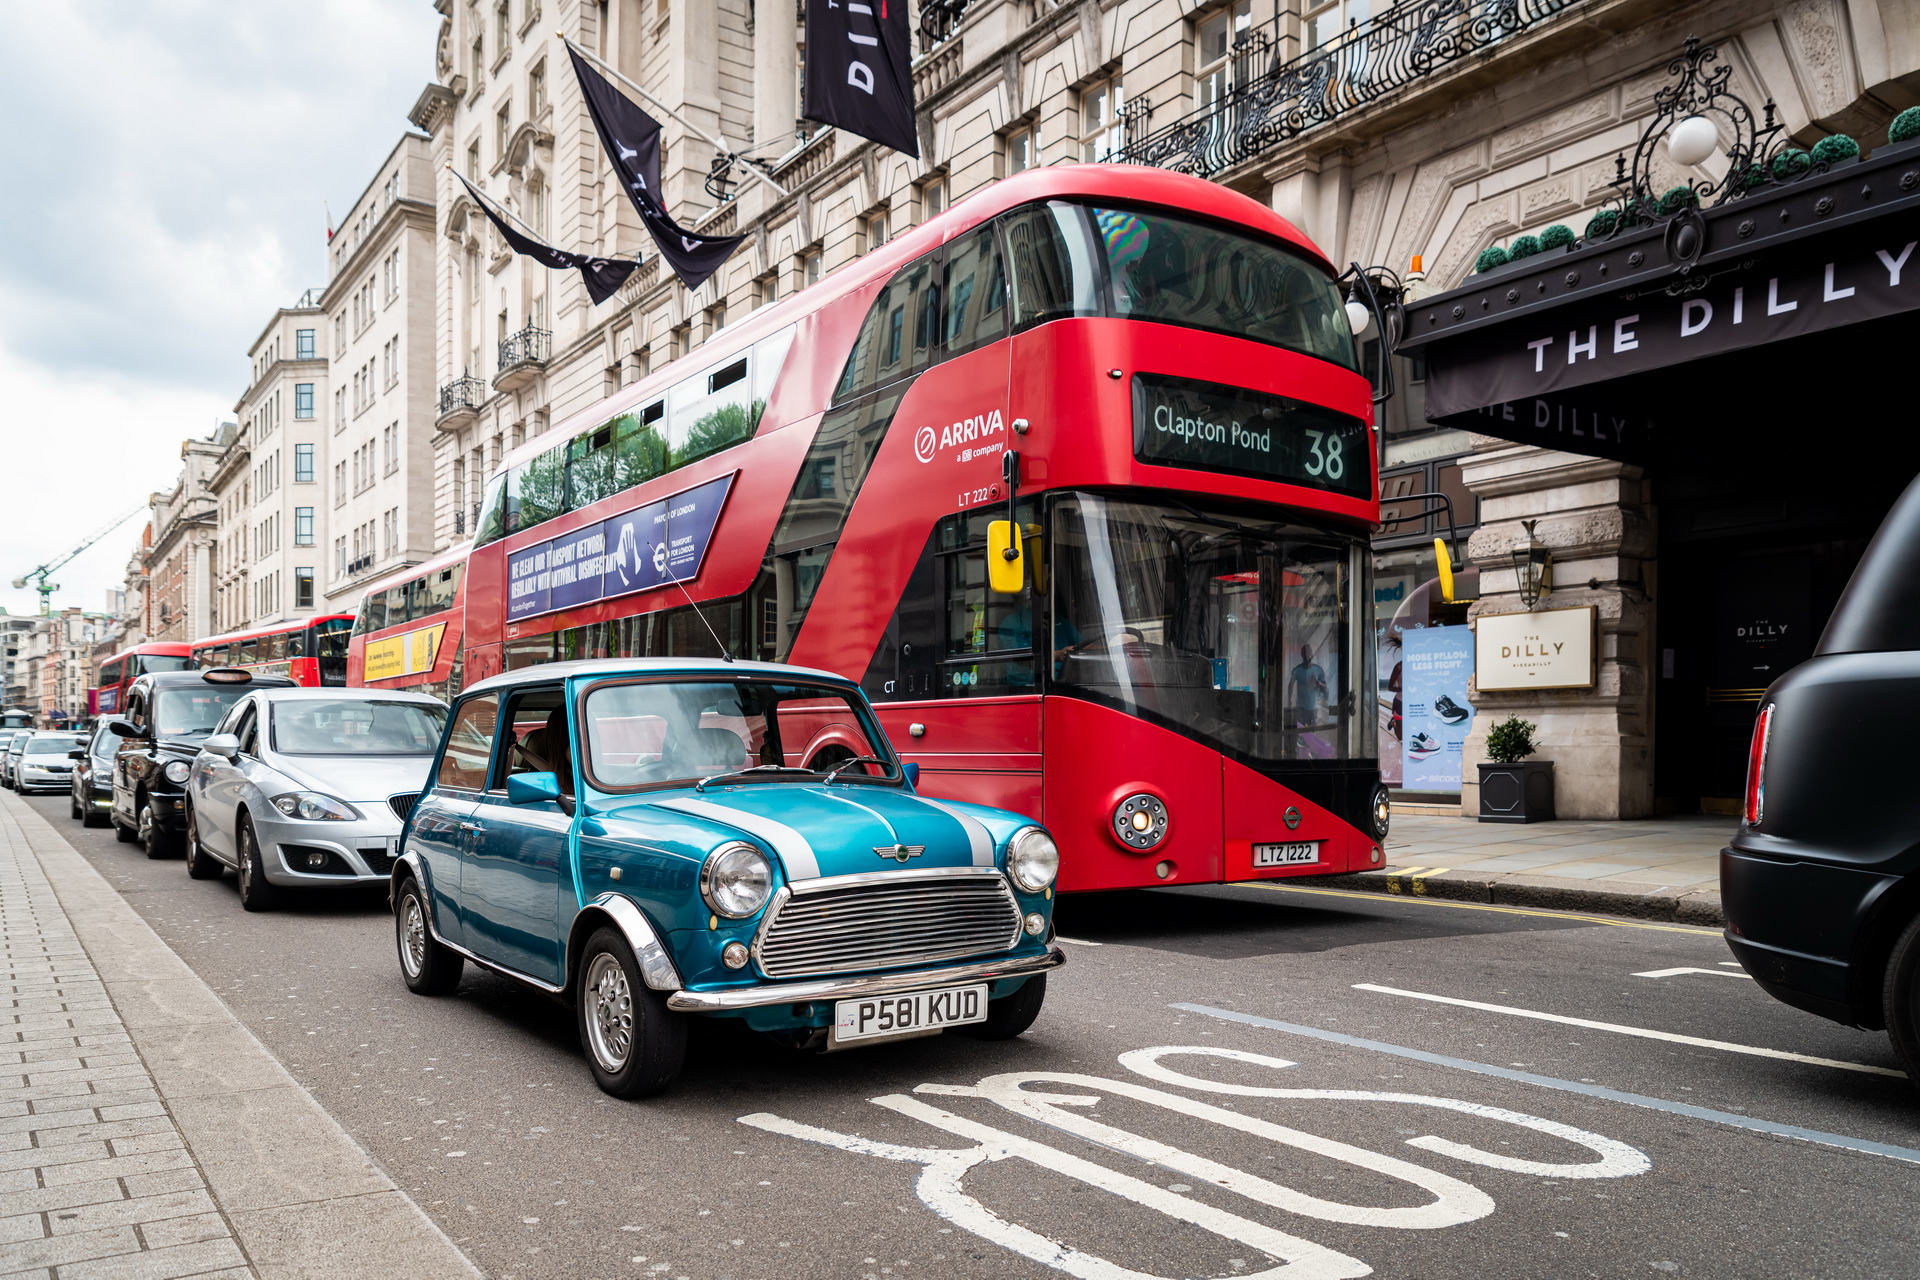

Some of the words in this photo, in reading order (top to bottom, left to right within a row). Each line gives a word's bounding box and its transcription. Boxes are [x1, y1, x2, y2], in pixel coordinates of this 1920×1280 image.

[1527, 314, 1640, 373] THE
[1680, 240, 1919, 338] DILLY
[939, 408, 1004, 450] ARRIVA
[1534, 398, 1626, 444] DILLY
[1154, 404, 1226, 444] Clapton
[1231, 420, 1271, 453] Pond
[1304, 428, 1344, 480] 38
[956, 454, 961, 463] a
[973, 442, 1004, 458] company
[958, 492, 970, 507] LT
[972, 487, 988, 504] 222
[670, 509, 677, 519] OF
[676, 502, 696, 517] LONDON
[670, 548, 678, 557] FOR
[678, 544, 695, 556] LONDON
[671, 535, 693, 548] TRANSPORT
[511, 561, 519, 579] WE
[519, 554, 534, 577] CLEAN
[1737, 624, 1788, 637] DILLY
[1406, 652, 1432, 663] MORE
[1501, 641, 1564, 658] DILLY
[1412, 661, 1433, 671] LESS
[884, 680, 896, 694] CT
[1428, 774, 1461, 784] BROOKS
[1260, 845, 1284, 863] LTZ
[1286, 844, 1312, 861] 1222
[858, 996, 920, 1034] P581
[928, 989, 979, 1024] KUD
